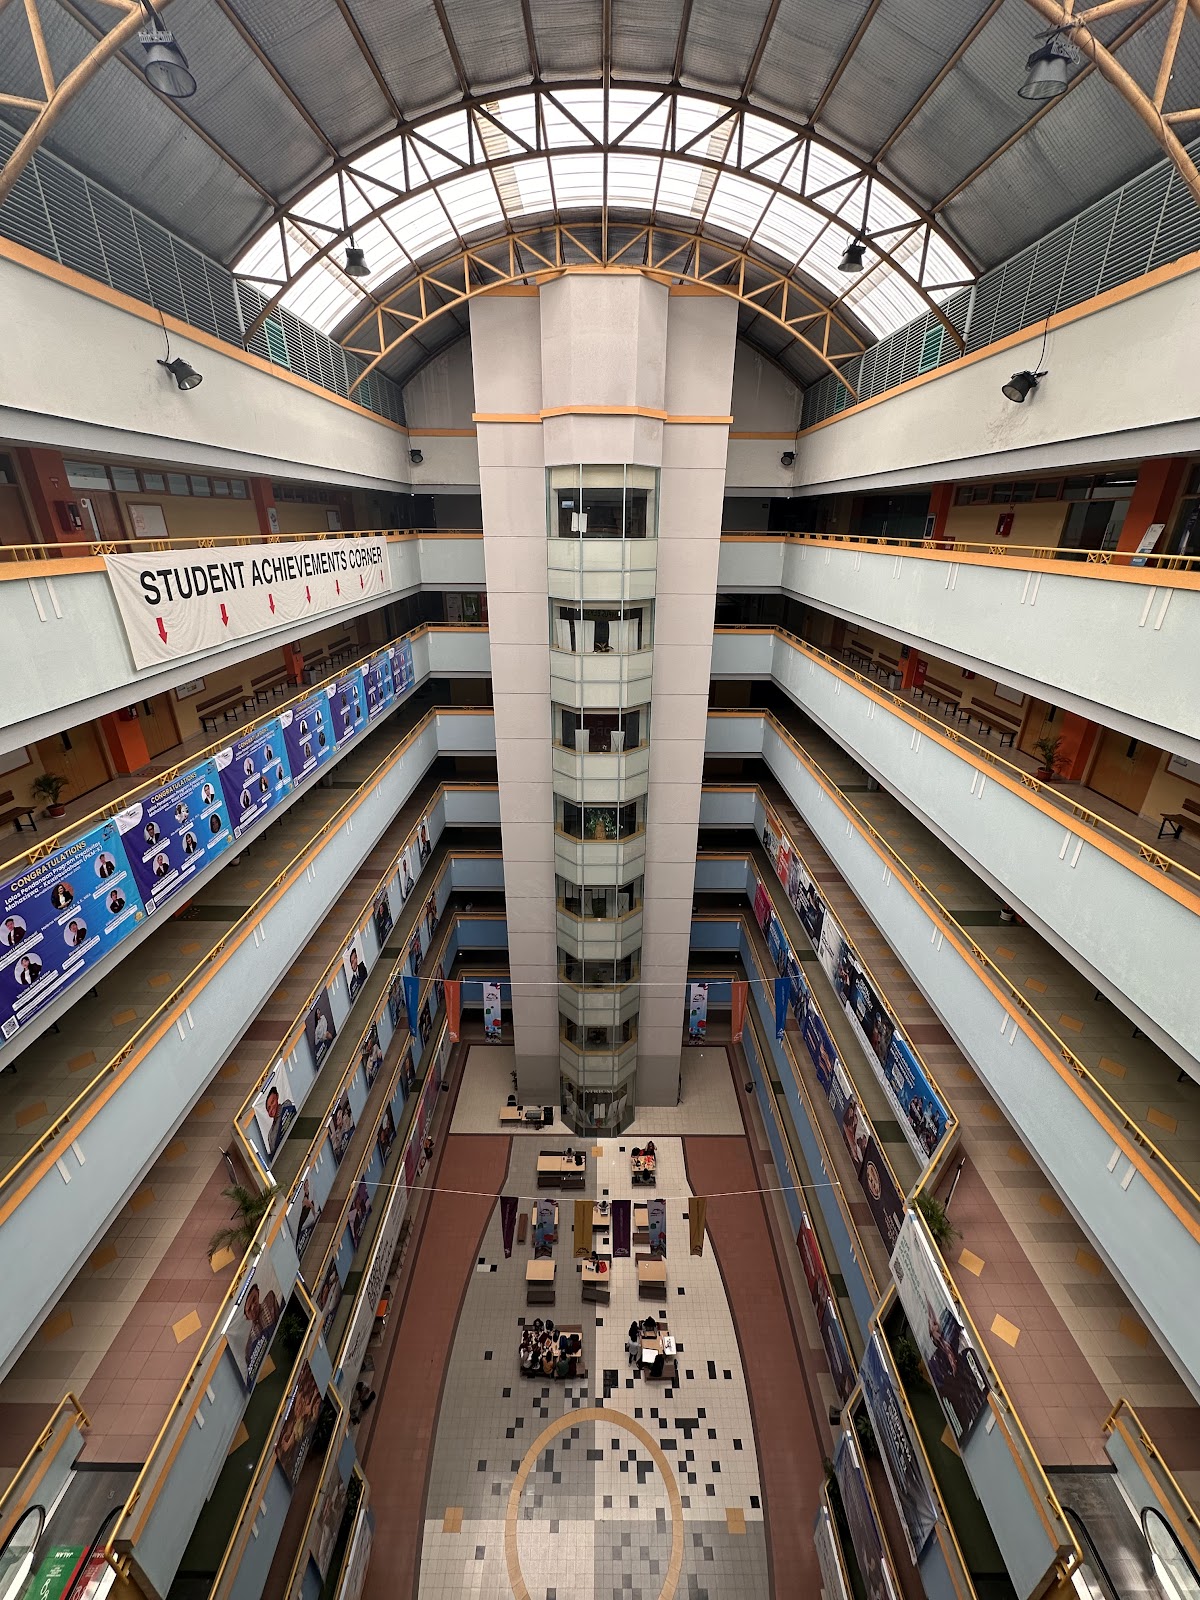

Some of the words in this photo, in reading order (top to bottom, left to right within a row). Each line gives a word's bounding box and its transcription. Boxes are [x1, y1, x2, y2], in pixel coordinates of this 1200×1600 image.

[140, 561, 245, 605] STUDENT
[252, 550, 347, 587] ACHIEVEMENTS
[349, 546, 383, 568] CORNER
[151, 772, 197, 803] CONGRATULATIONS
[4, 891, 20, 905] Lolos
[20, 871, 53, 895] Pendanaan
[52, 857, 76, 875] Program
[10, 840, 87, 892] CONGRATULATIONS
[5, 889, 39, 912] Mahasiswa
